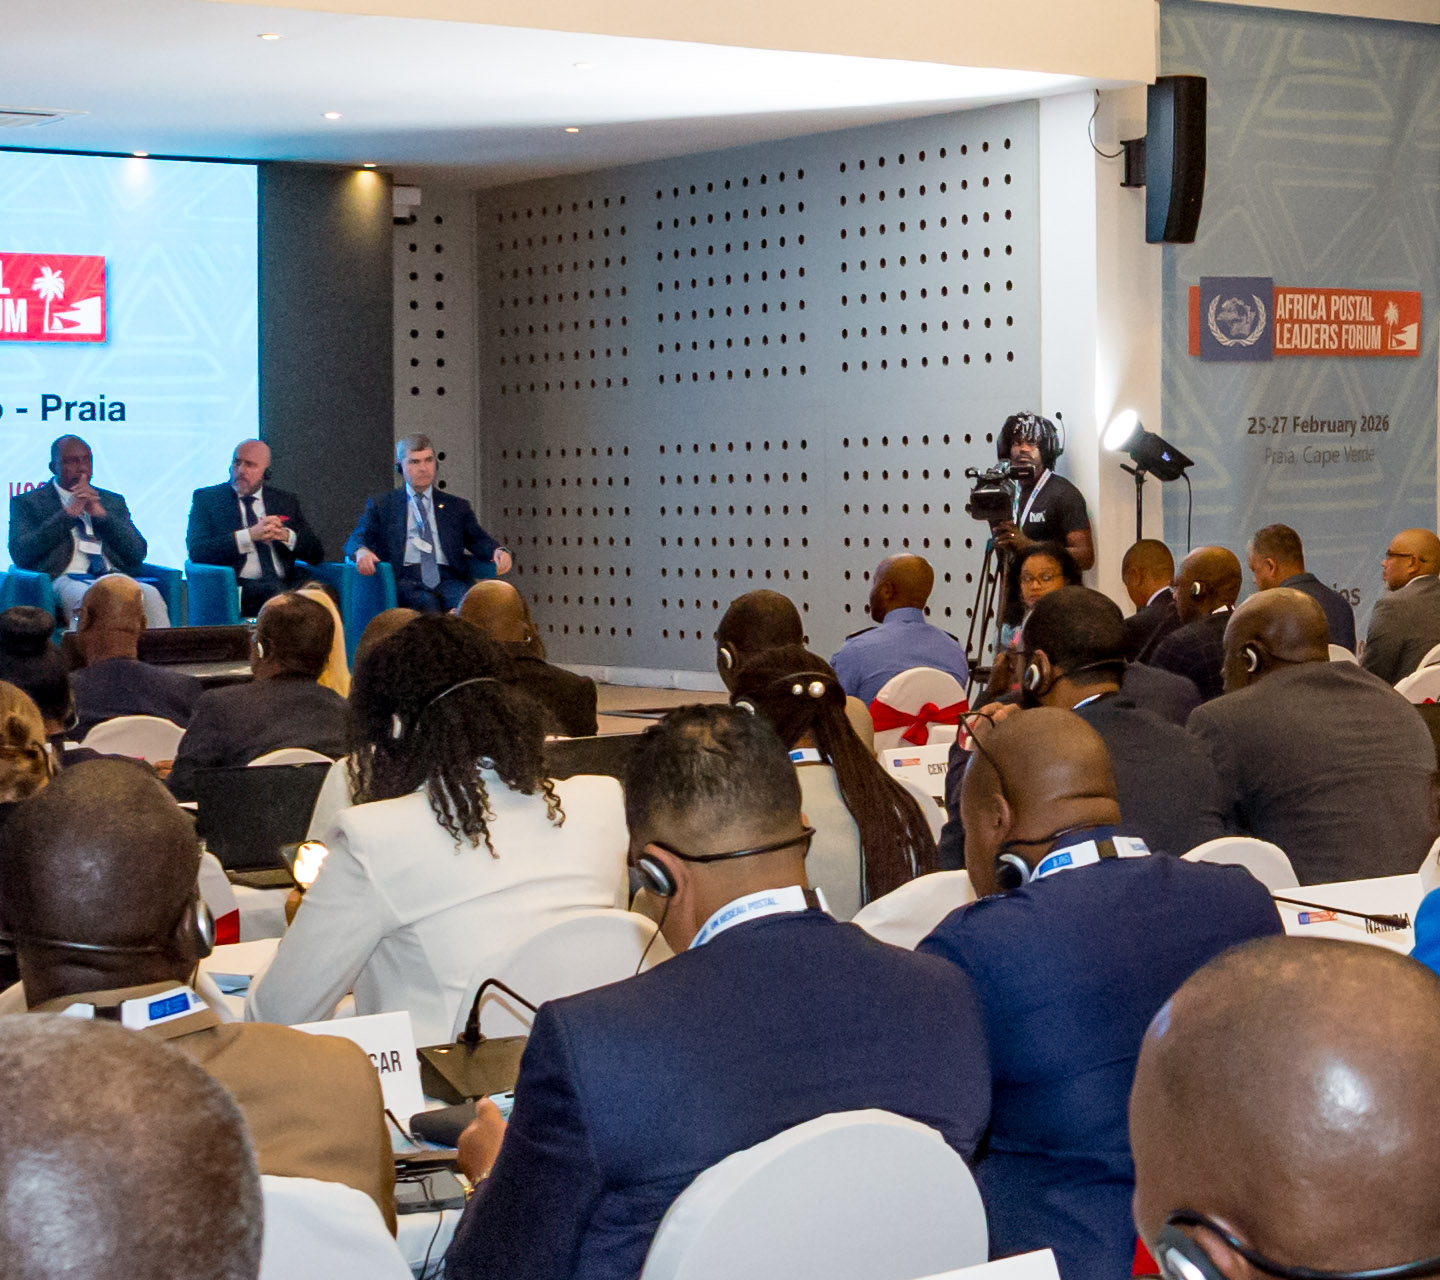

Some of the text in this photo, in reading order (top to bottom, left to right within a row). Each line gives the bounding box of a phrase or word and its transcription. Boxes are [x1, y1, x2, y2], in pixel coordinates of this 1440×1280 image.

[1276, 294, 1374, 322] AFRICA POSTAL
[1276, 323, 1381, 350] LEADERS FORUM
[41, 393, 126, 421] Praia
[1247, 414, 1390, 437] 25-27 February 2026
[1303, 445, 1340, 468] Cape
